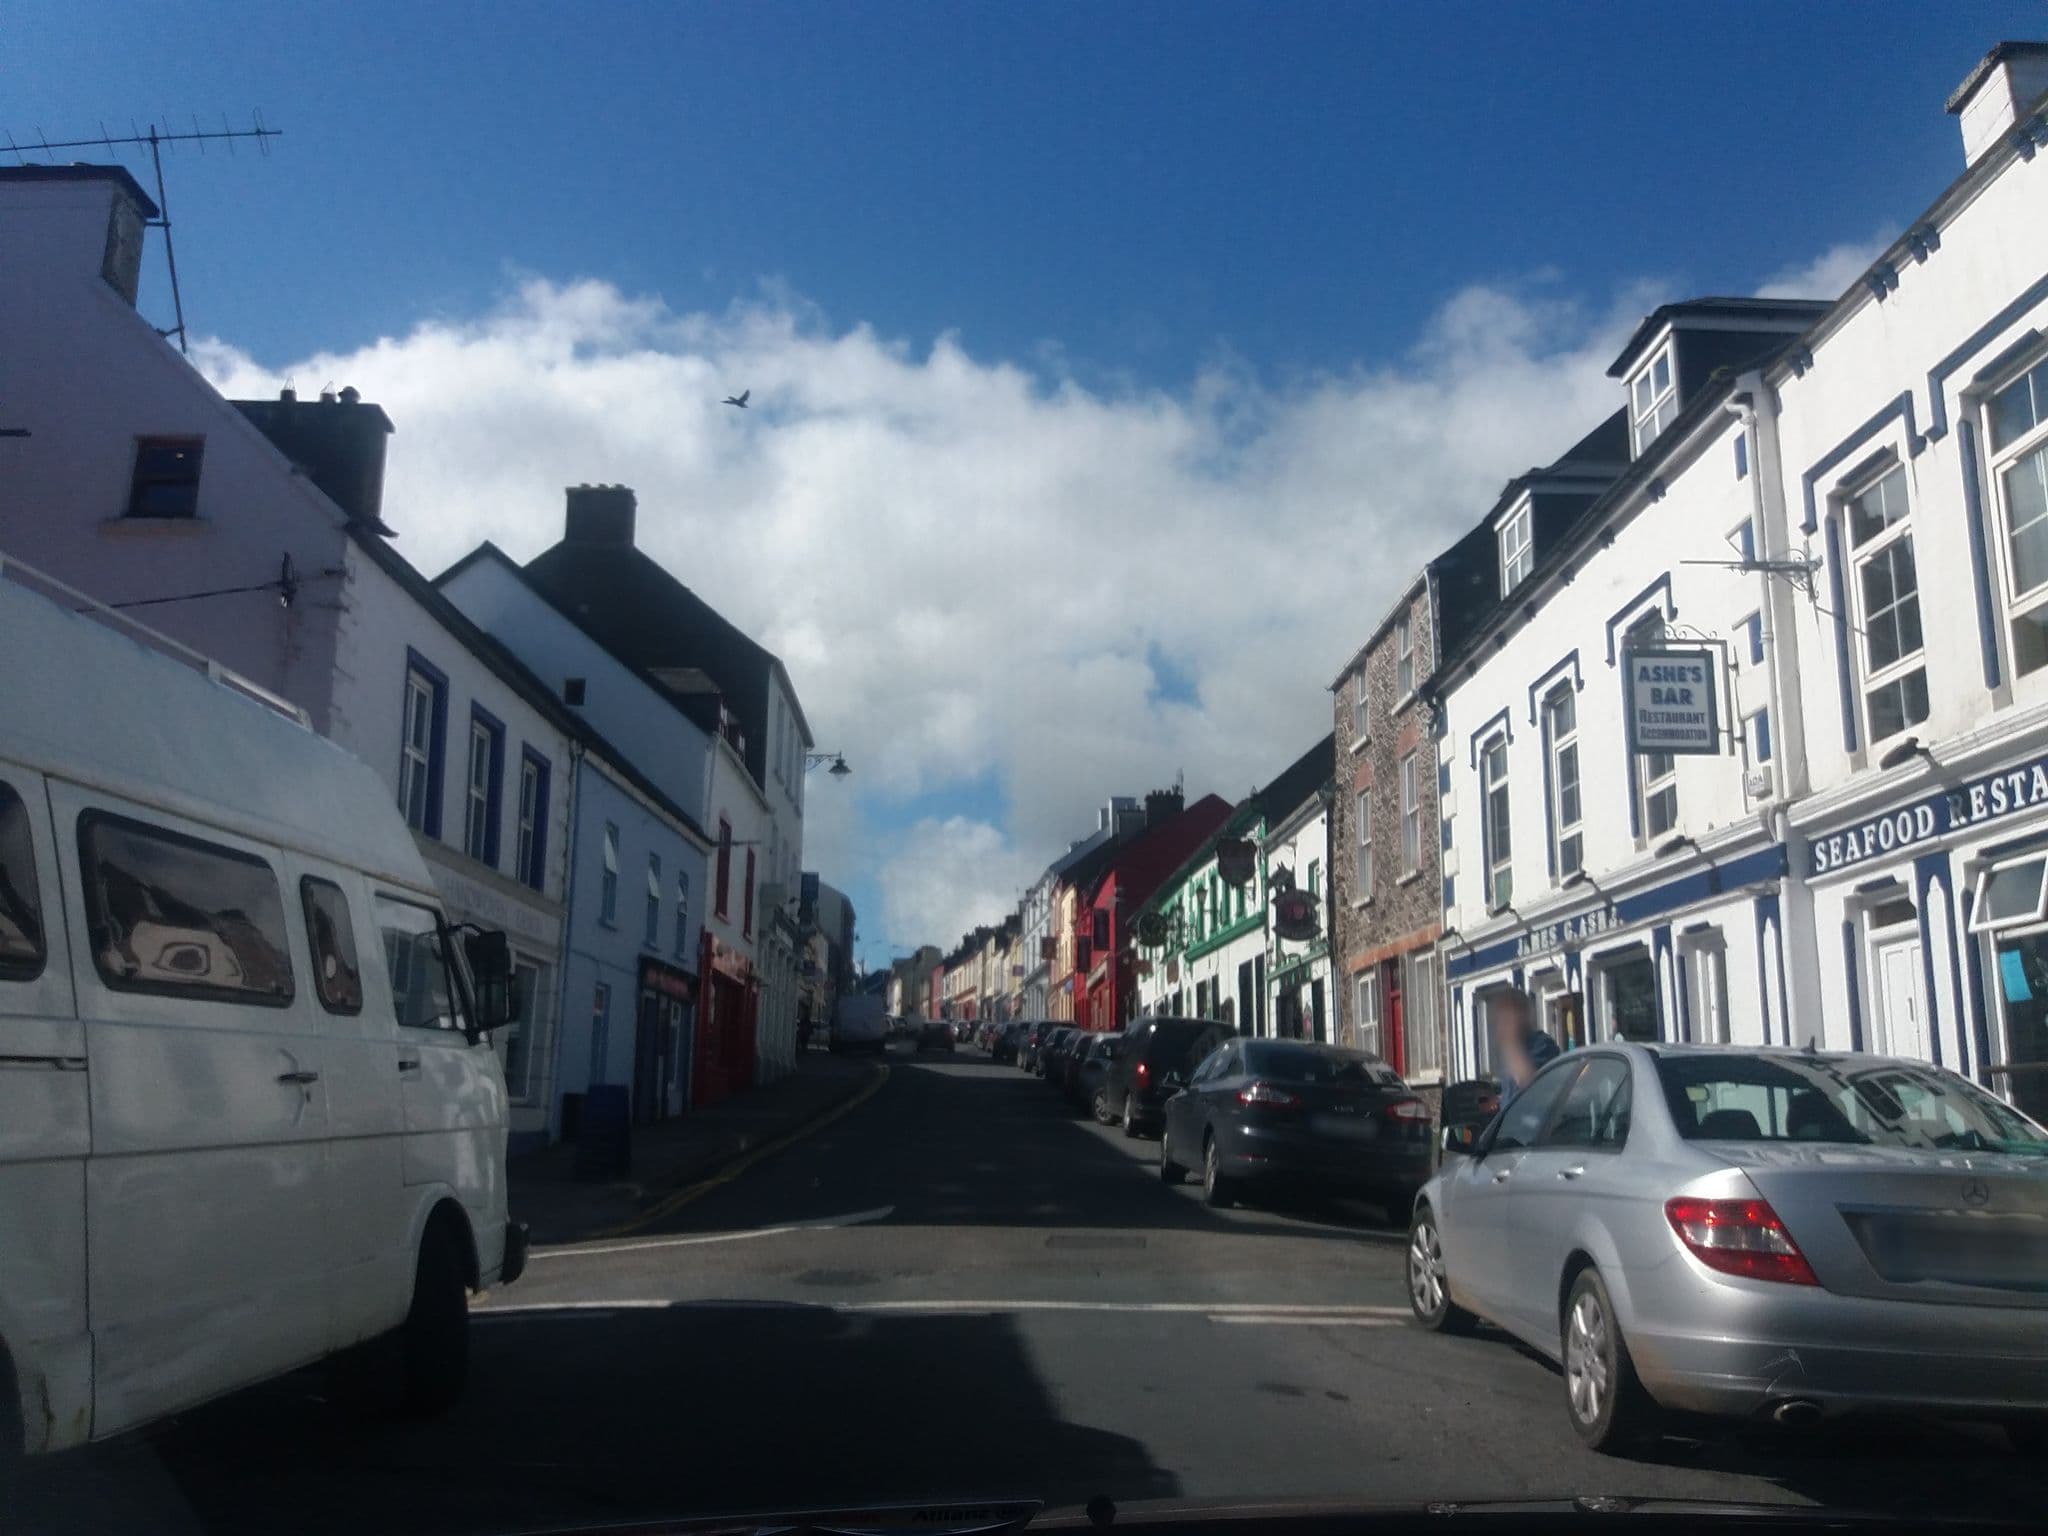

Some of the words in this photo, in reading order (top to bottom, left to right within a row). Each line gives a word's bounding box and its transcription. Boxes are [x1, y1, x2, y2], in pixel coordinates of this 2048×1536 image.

[1638, 665, 1703, 683] ASHE'S
[1650, 687, 1694, 705] BAR
[1814, 804, 1935, 873] SEAFOOD
[1517, 924, 1558, 958] JAMES
